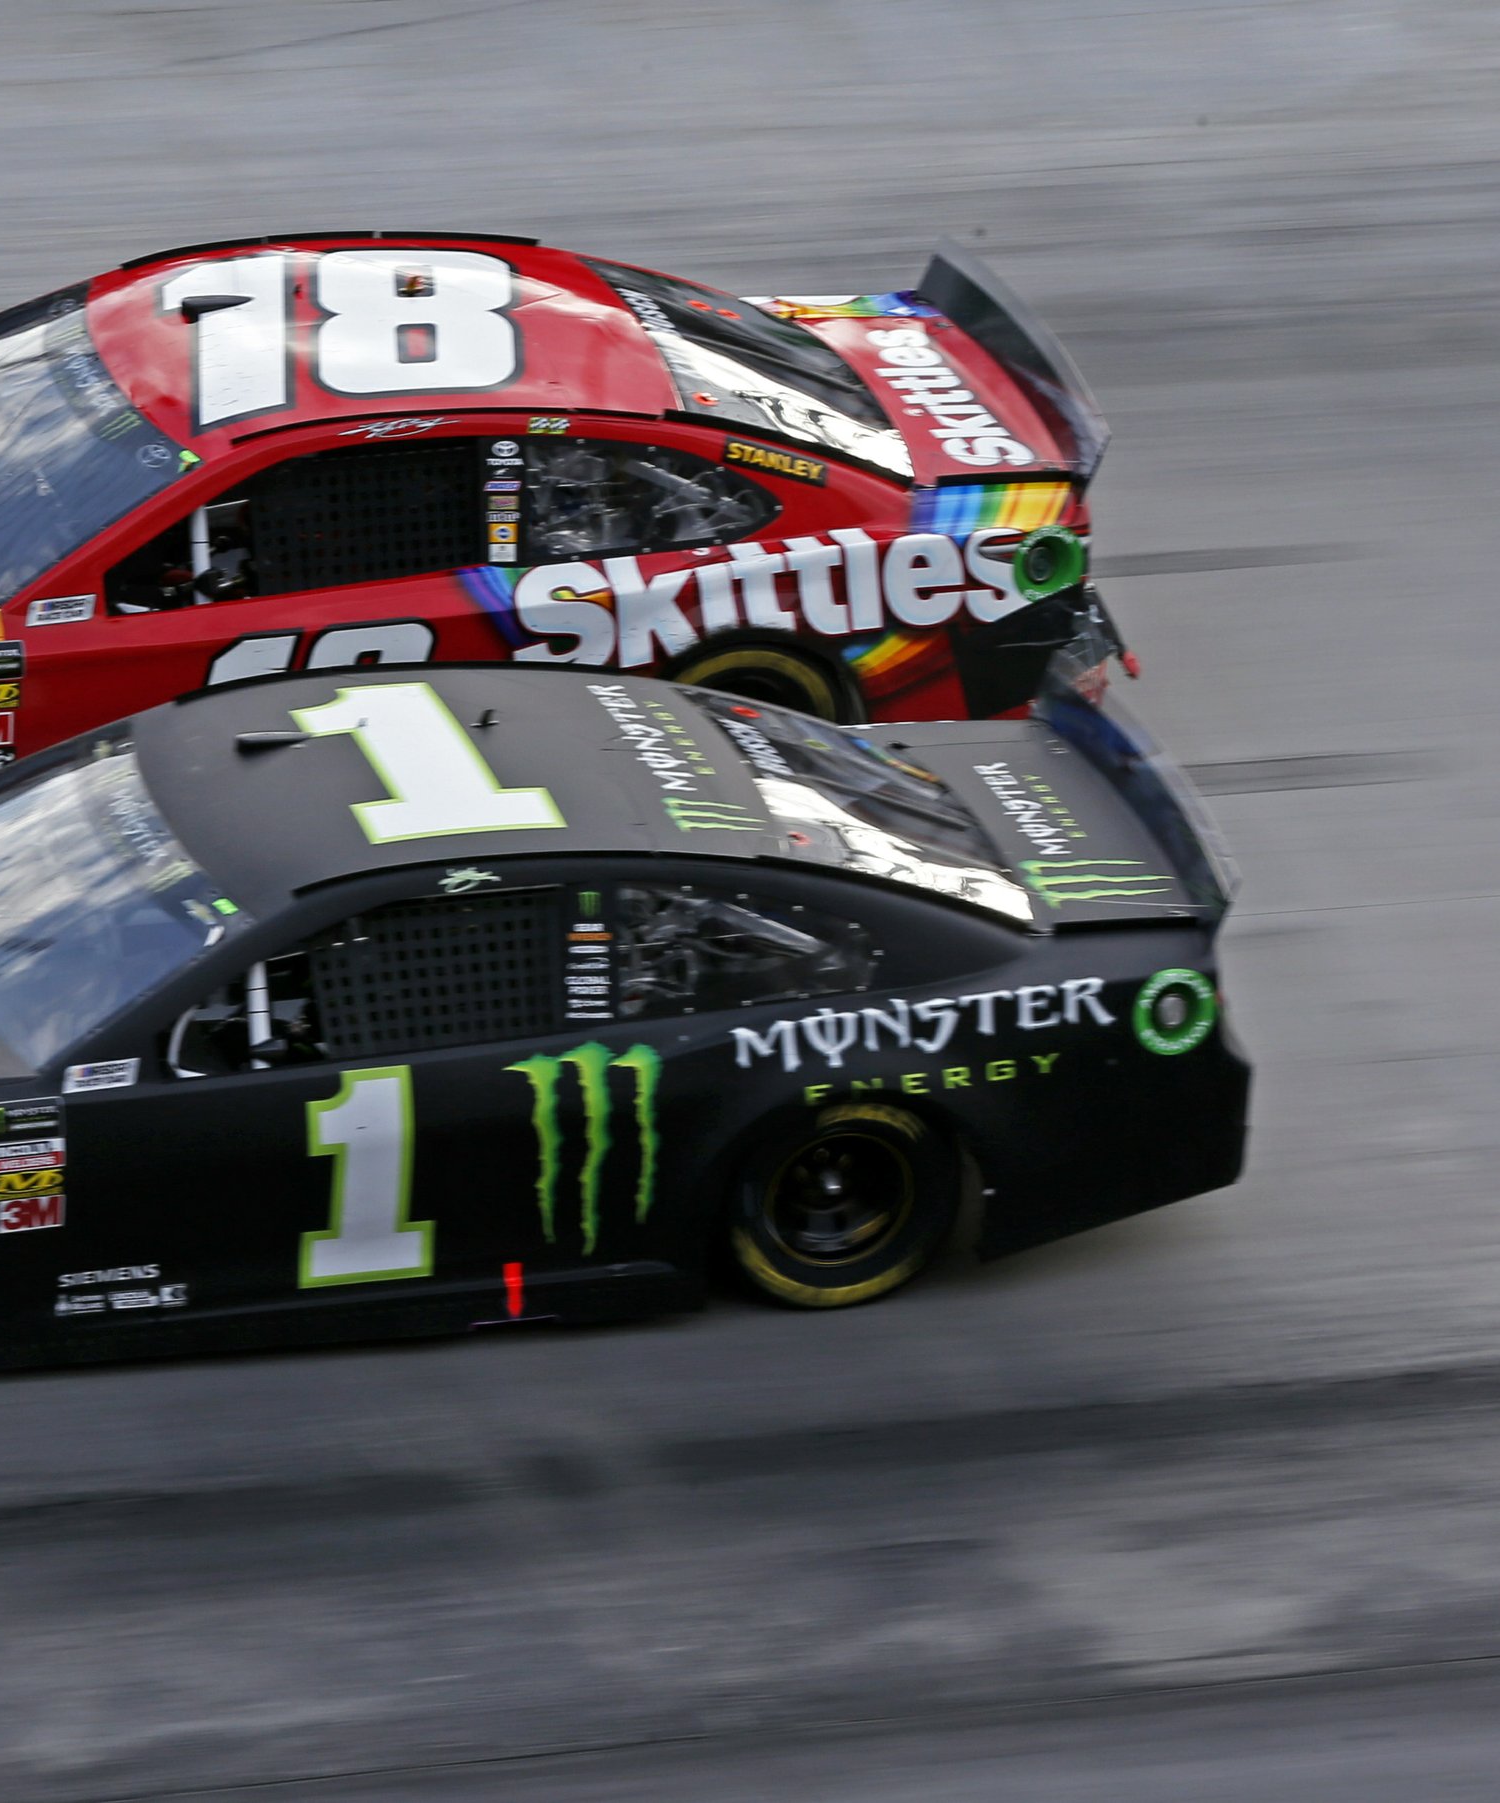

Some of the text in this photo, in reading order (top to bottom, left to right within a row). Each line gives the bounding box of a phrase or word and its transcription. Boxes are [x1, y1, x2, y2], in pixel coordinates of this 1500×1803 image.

[160, 249, 516, 430] 18
[865, 329, 1036, 467] Skittles
[726, 442, 826, 479] STANLEY
[513, 527, 1033, 669] Skittles
[290, 682, 567, 845] 1
[586, 685, 698, 792] MONSTER
[972, 762, 1073, 855] MONSTER
[728, 976, 1117, 1072] MONSTER
[2, 1195, 61, 1231] 3M
[299, 1065, 435, 1288] 1
[57, 1264, 161, 1288] SIEMENS
